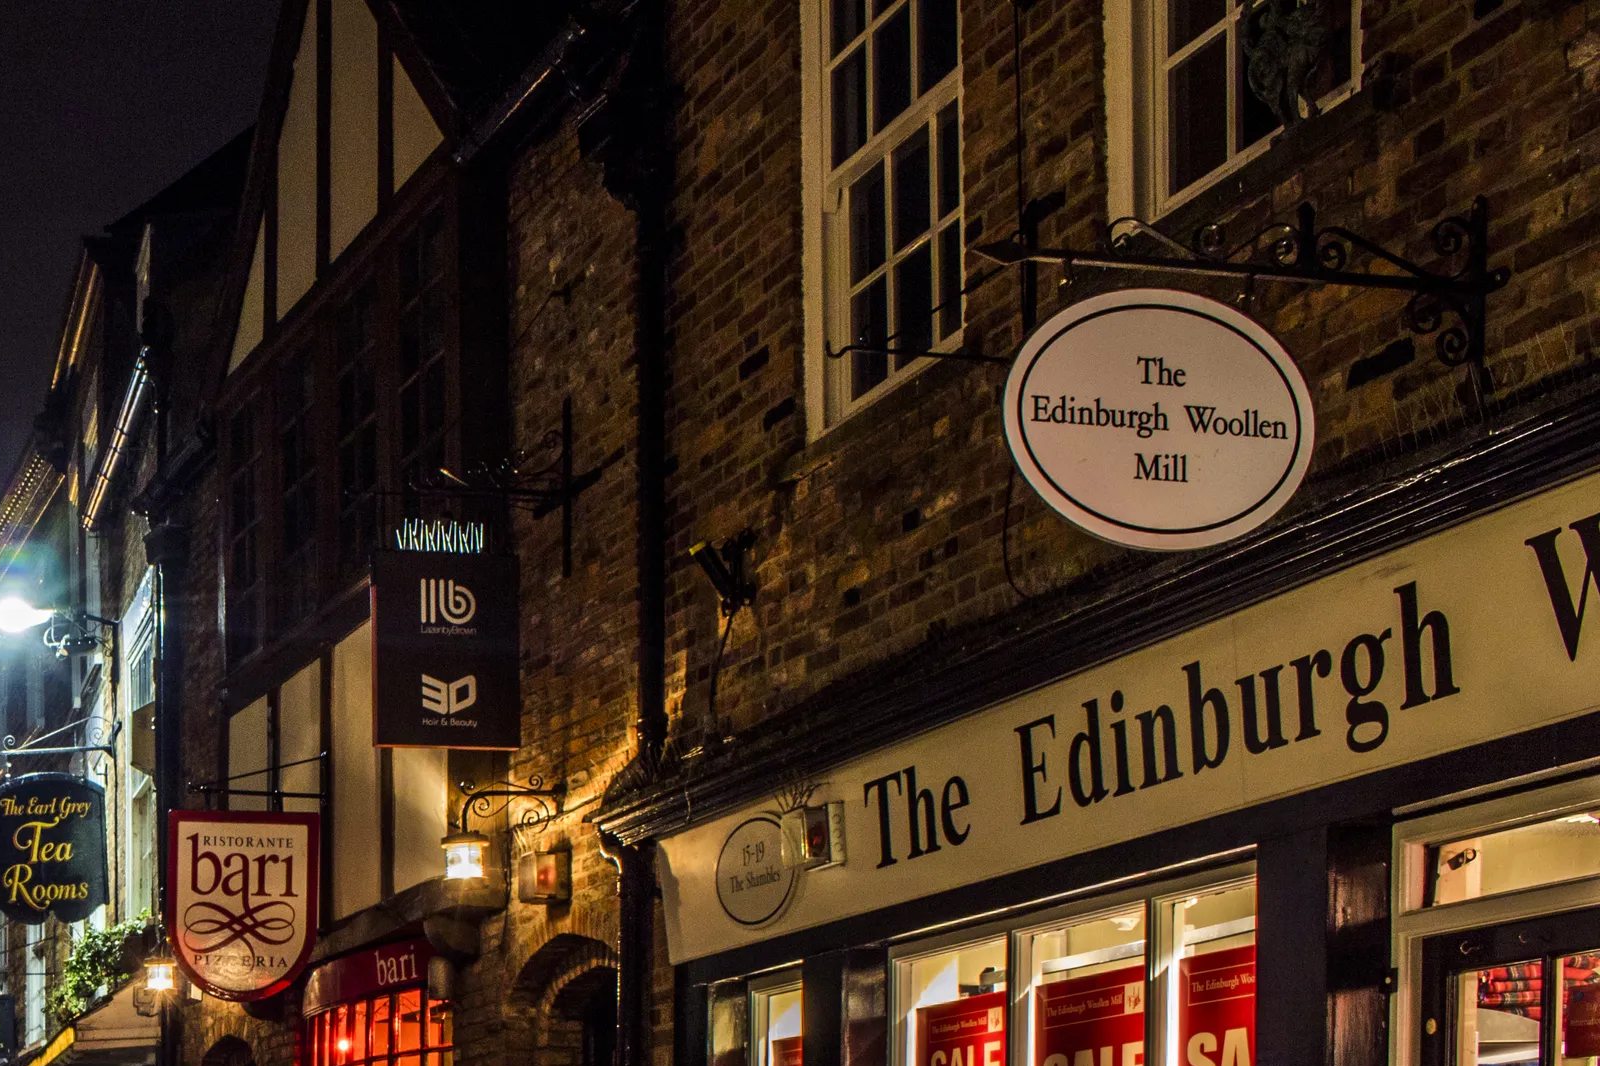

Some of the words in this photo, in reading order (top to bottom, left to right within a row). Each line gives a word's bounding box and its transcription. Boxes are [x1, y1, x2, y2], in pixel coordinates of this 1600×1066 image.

[1137, 356, 1186, 387] The
[1031, 395, 1169, 438] Edinburgh
[1184, 405, 1288, 440] Woollen
[1133, 453, 1188, 483] Mill
[422, 718, 439, 726] Hair
[441, 718, 448, 726] &
[450, 718, 478, 728] Beauty
[863, 763, 971, 870] The
[1013, 581, 1461, 825] Edinburgh
[0, 795, 25, 816] The
[27, 796, 56, 815] Earl
[59, 796, 92, 819] Grey
[13, 816, 74, 864] Tea
[203, 835, 294, 849] RISTORANTE
[742, 841, 765, 867] 15-19
[186, 832, 299, 898] bari
[2, 864, 89, 910] Rooms
[730, 875, 744, 893] The
[746, 866, 782, 890] Shambles
[194, 954, 288, 968] PIZZERIA
[374, 944, 418, 986] bari
[1192, 981, 1204, 993] The
[1205, 974, 1239, 990] Edinburgh
[1047, 1007, 1057, 1017] The
[1058, 1000, 1085, 1015] Edinburgh
[1087, 997, 1109, 1009] Woollen
[1110, 992, 1124, 1006] Mill
